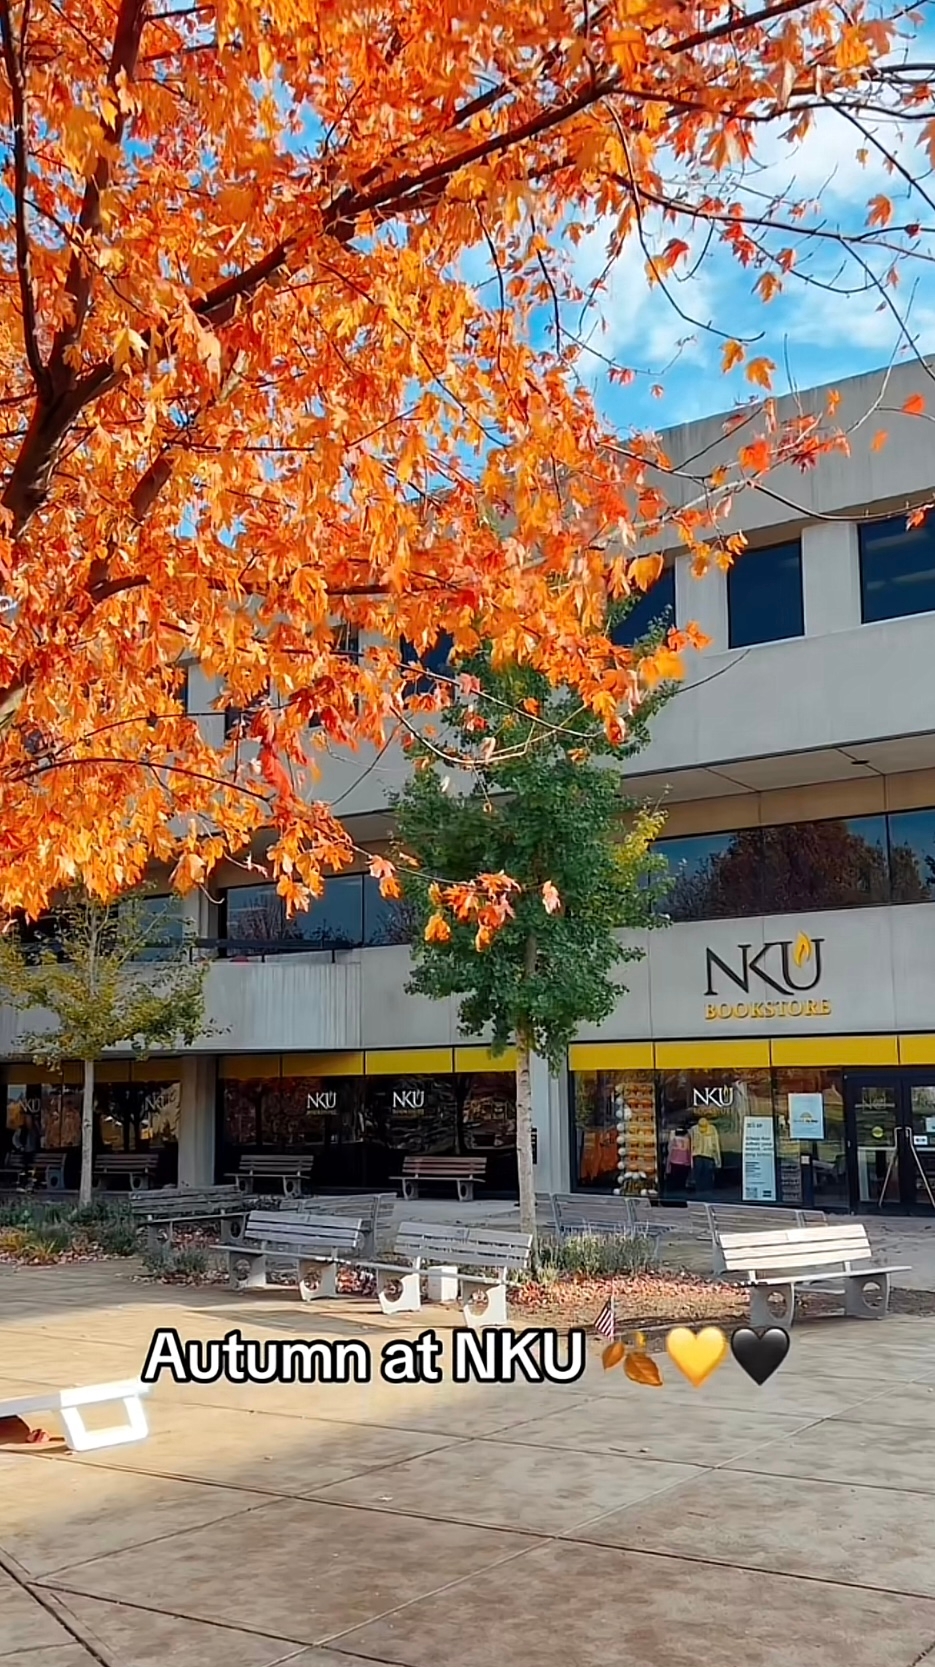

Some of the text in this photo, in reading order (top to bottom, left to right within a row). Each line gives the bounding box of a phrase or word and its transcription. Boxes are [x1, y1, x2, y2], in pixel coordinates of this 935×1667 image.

[703, 935, 825, 996] NKU
[704, 999, 832, 1020] BOOKSTORE
[306, 1090, 337, 1109] NKU
[392, 1088, 424, 1108] NKU
[693, 1086, 734, 1107] NKU
